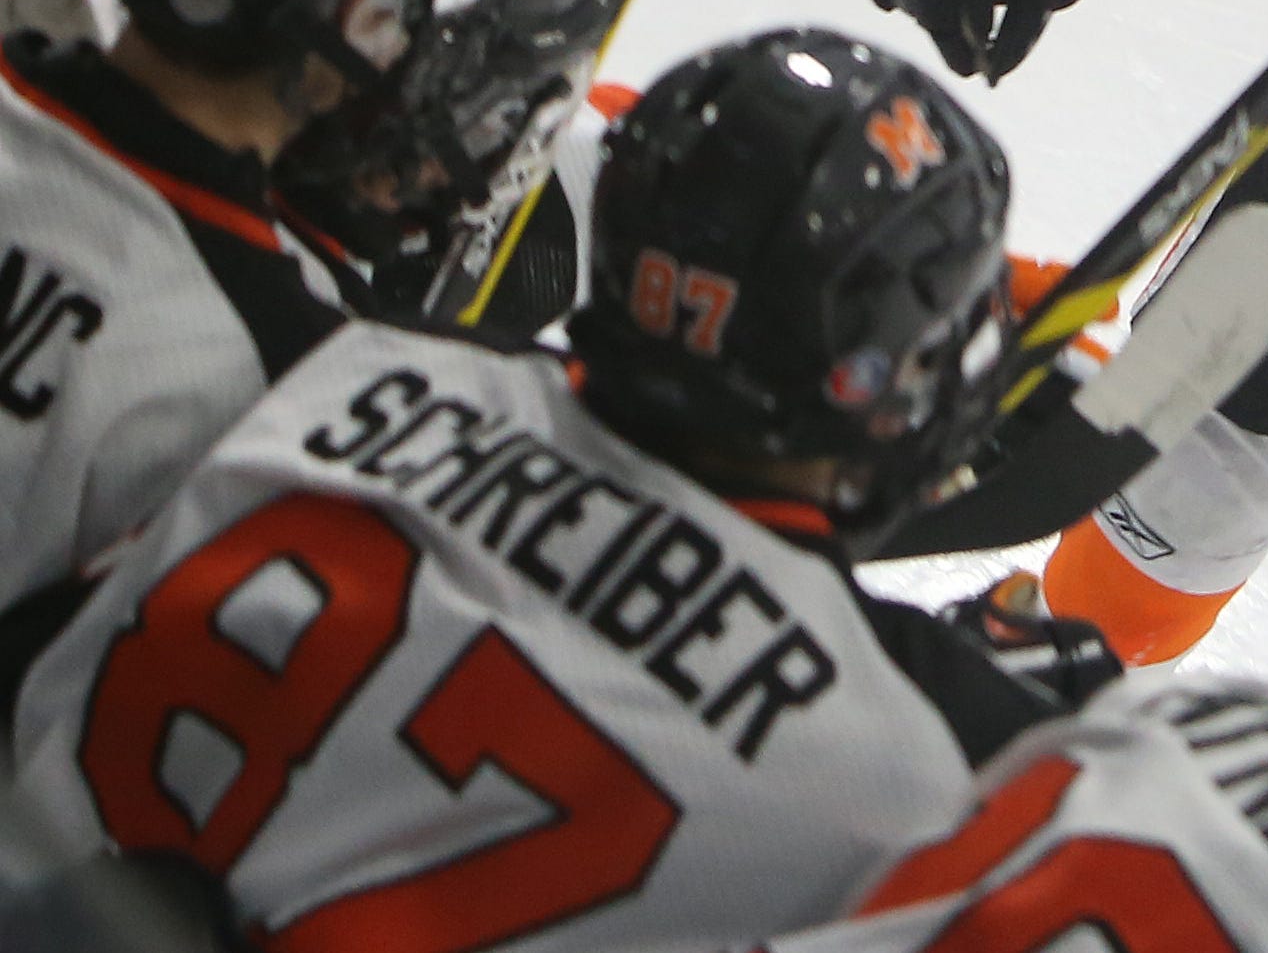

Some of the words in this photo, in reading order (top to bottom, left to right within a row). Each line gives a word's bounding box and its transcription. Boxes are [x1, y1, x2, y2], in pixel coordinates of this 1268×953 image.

[629, 248, 739, 359] 87
[76, 490, 684, 953] 87
[302, 368, 838, 765] SCHREIBER
